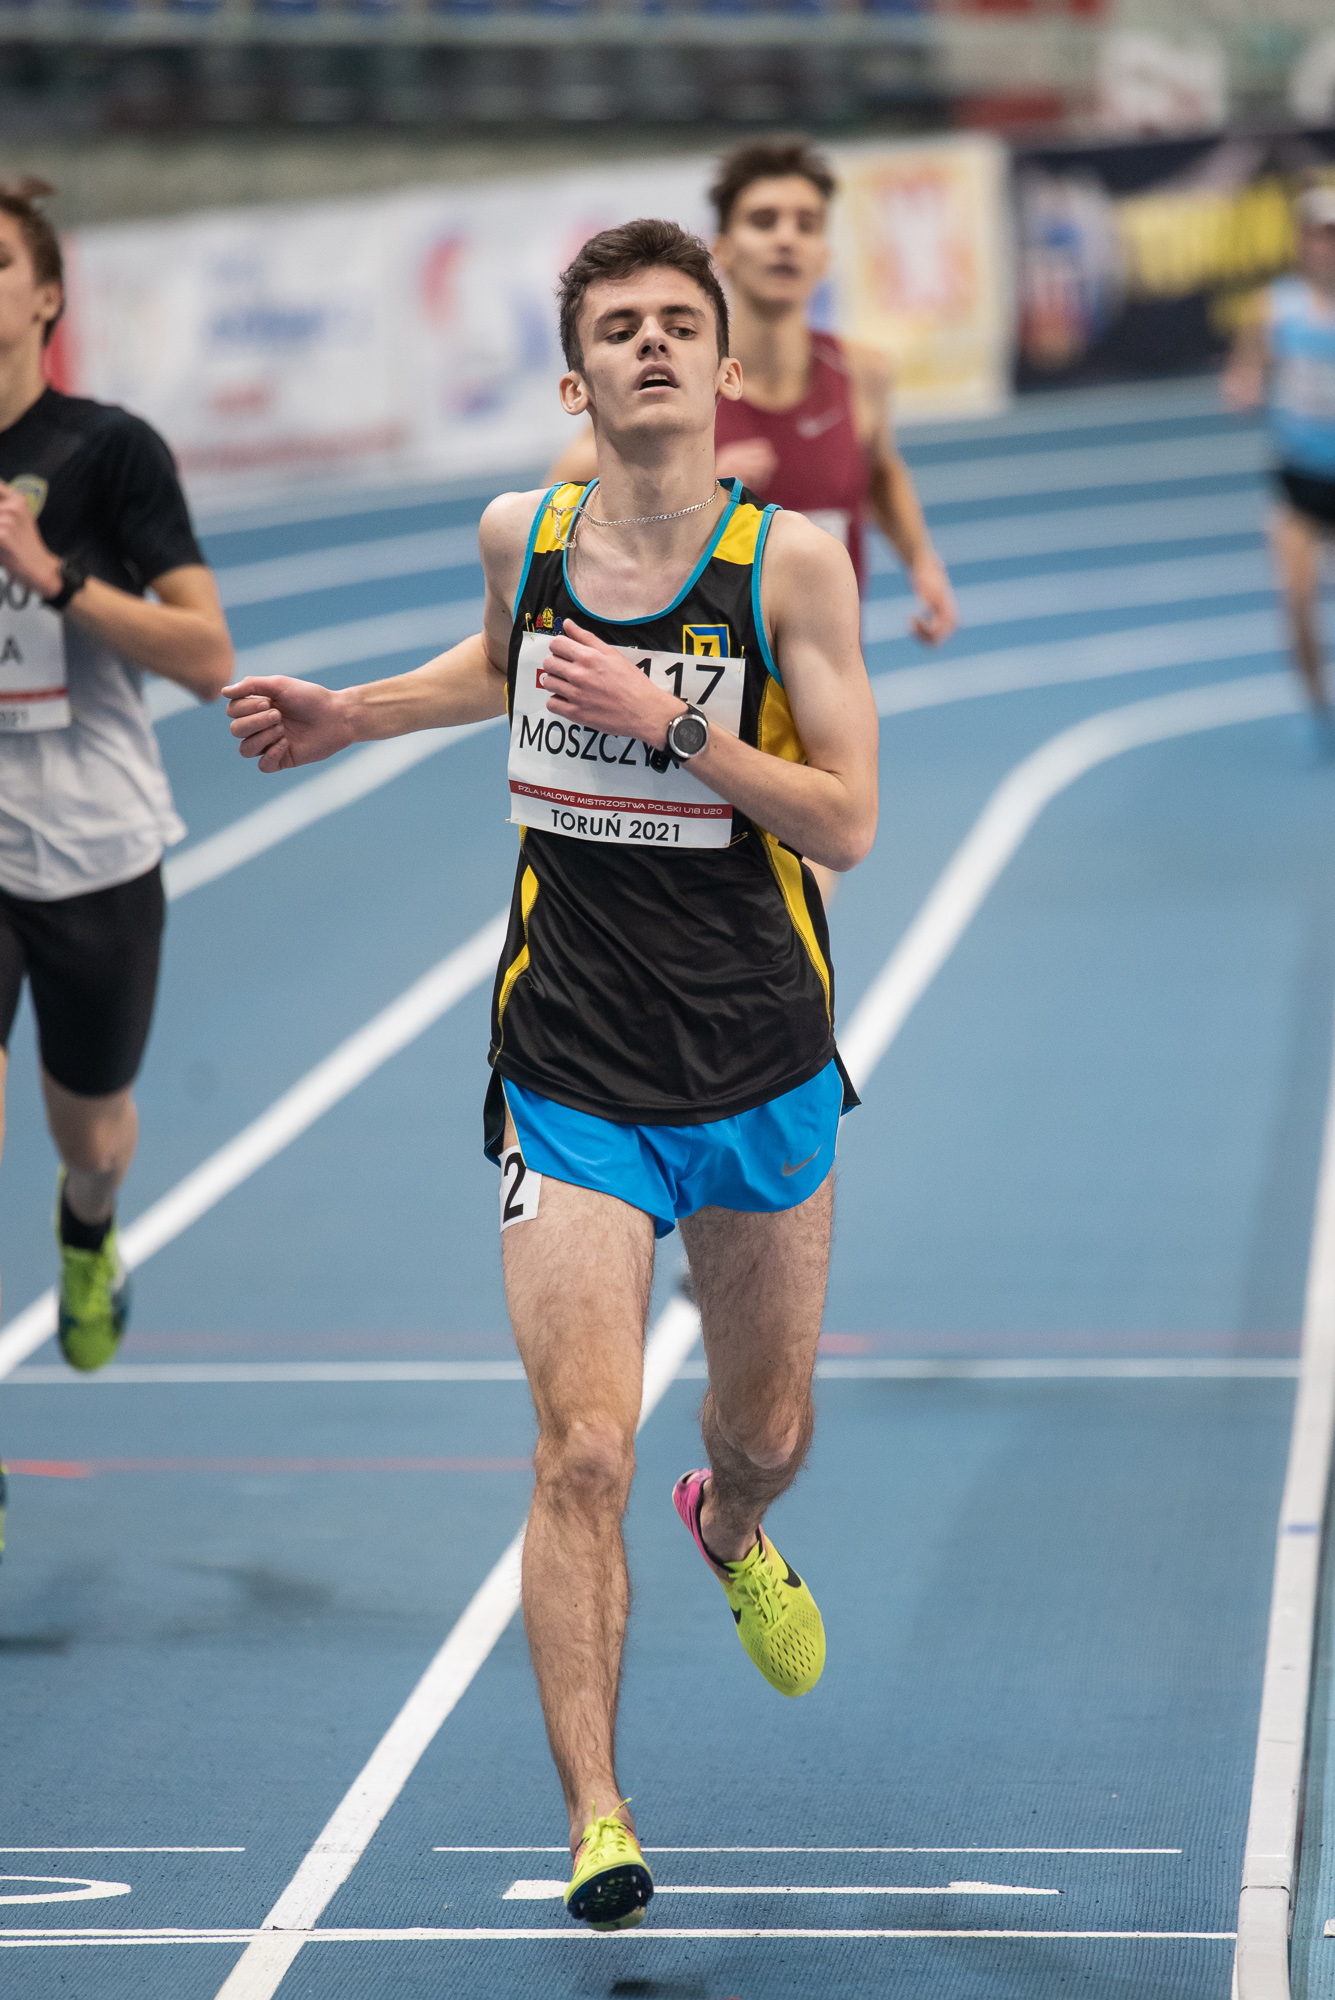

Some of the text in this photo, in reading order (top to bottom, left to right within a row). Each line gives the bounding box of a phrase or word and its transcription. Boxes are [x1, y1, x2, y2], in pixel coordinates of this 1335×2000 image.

[519, 714, 681, 770] MOSZCZY
[517, 785, 540, 795] PZLA
[540, 791, 576, 803] HALOWE
[576, 797, 646, 809] MISTRZOSTWA
[647, 803, 682, 813] POLSKI
[551, 809, 680, 842] TORUŃ 2021
[503, 1152, 526, 1225] 2
